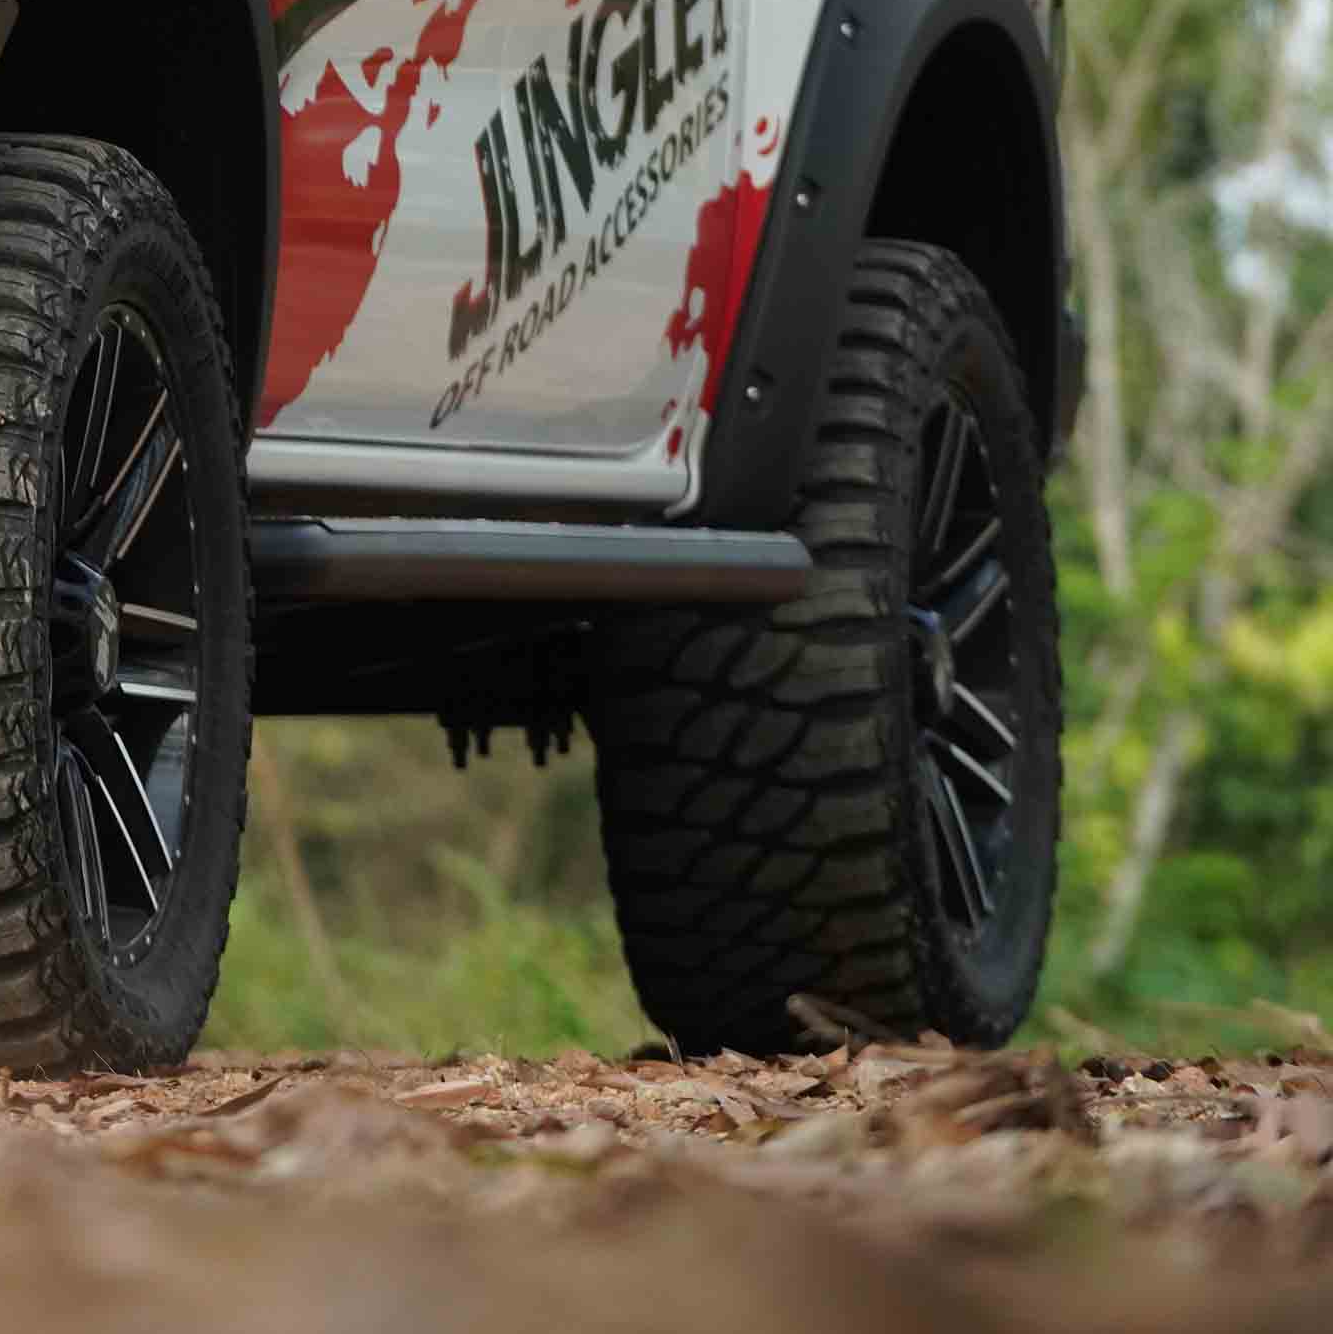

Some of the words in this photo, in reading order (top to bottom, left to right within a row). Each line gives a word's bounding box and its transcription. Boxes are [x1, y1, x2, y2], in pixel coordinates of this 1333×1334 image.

[429, 344, 496, 430] OFF
[498, 262, 578, 376] ROAD
[581, 69, 730, 291] ACCESSORIES
